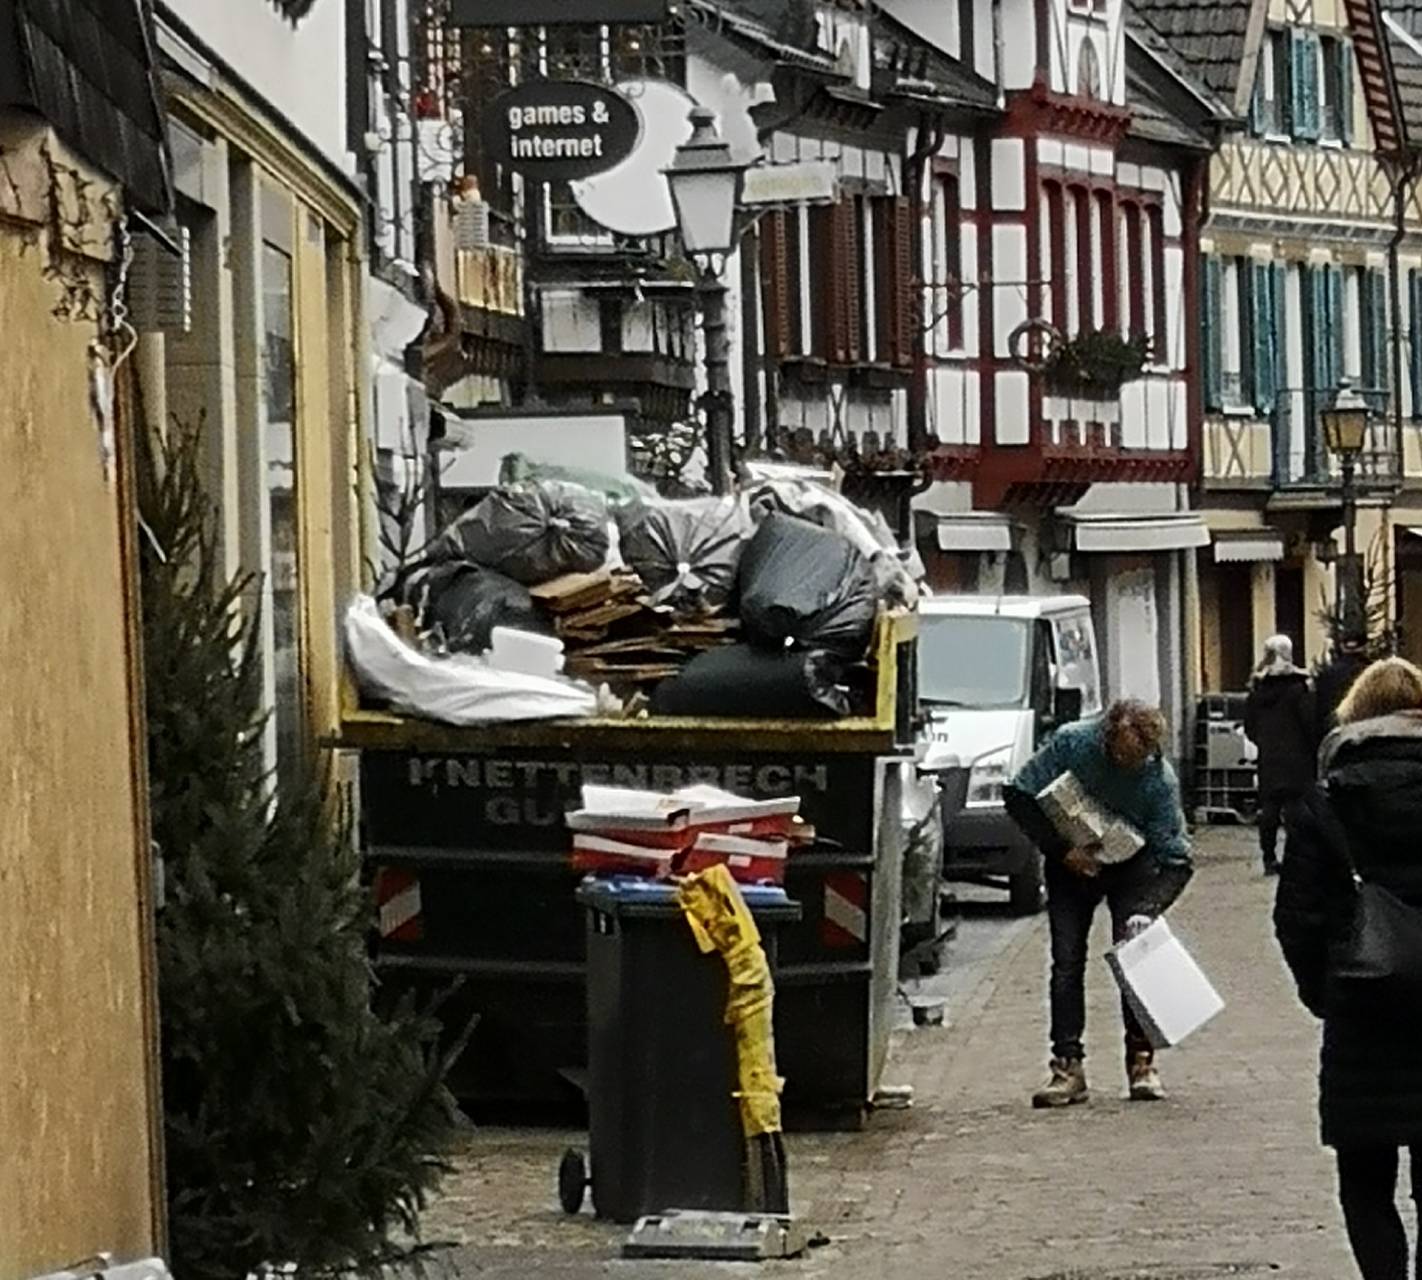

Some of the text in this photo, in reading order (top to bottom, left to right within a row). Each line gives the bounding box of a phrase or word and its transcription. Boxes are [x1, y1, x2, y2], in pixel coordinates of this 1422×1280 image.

[508, 100, 609, 130] games &
[511, 133, 603, 158] internet
